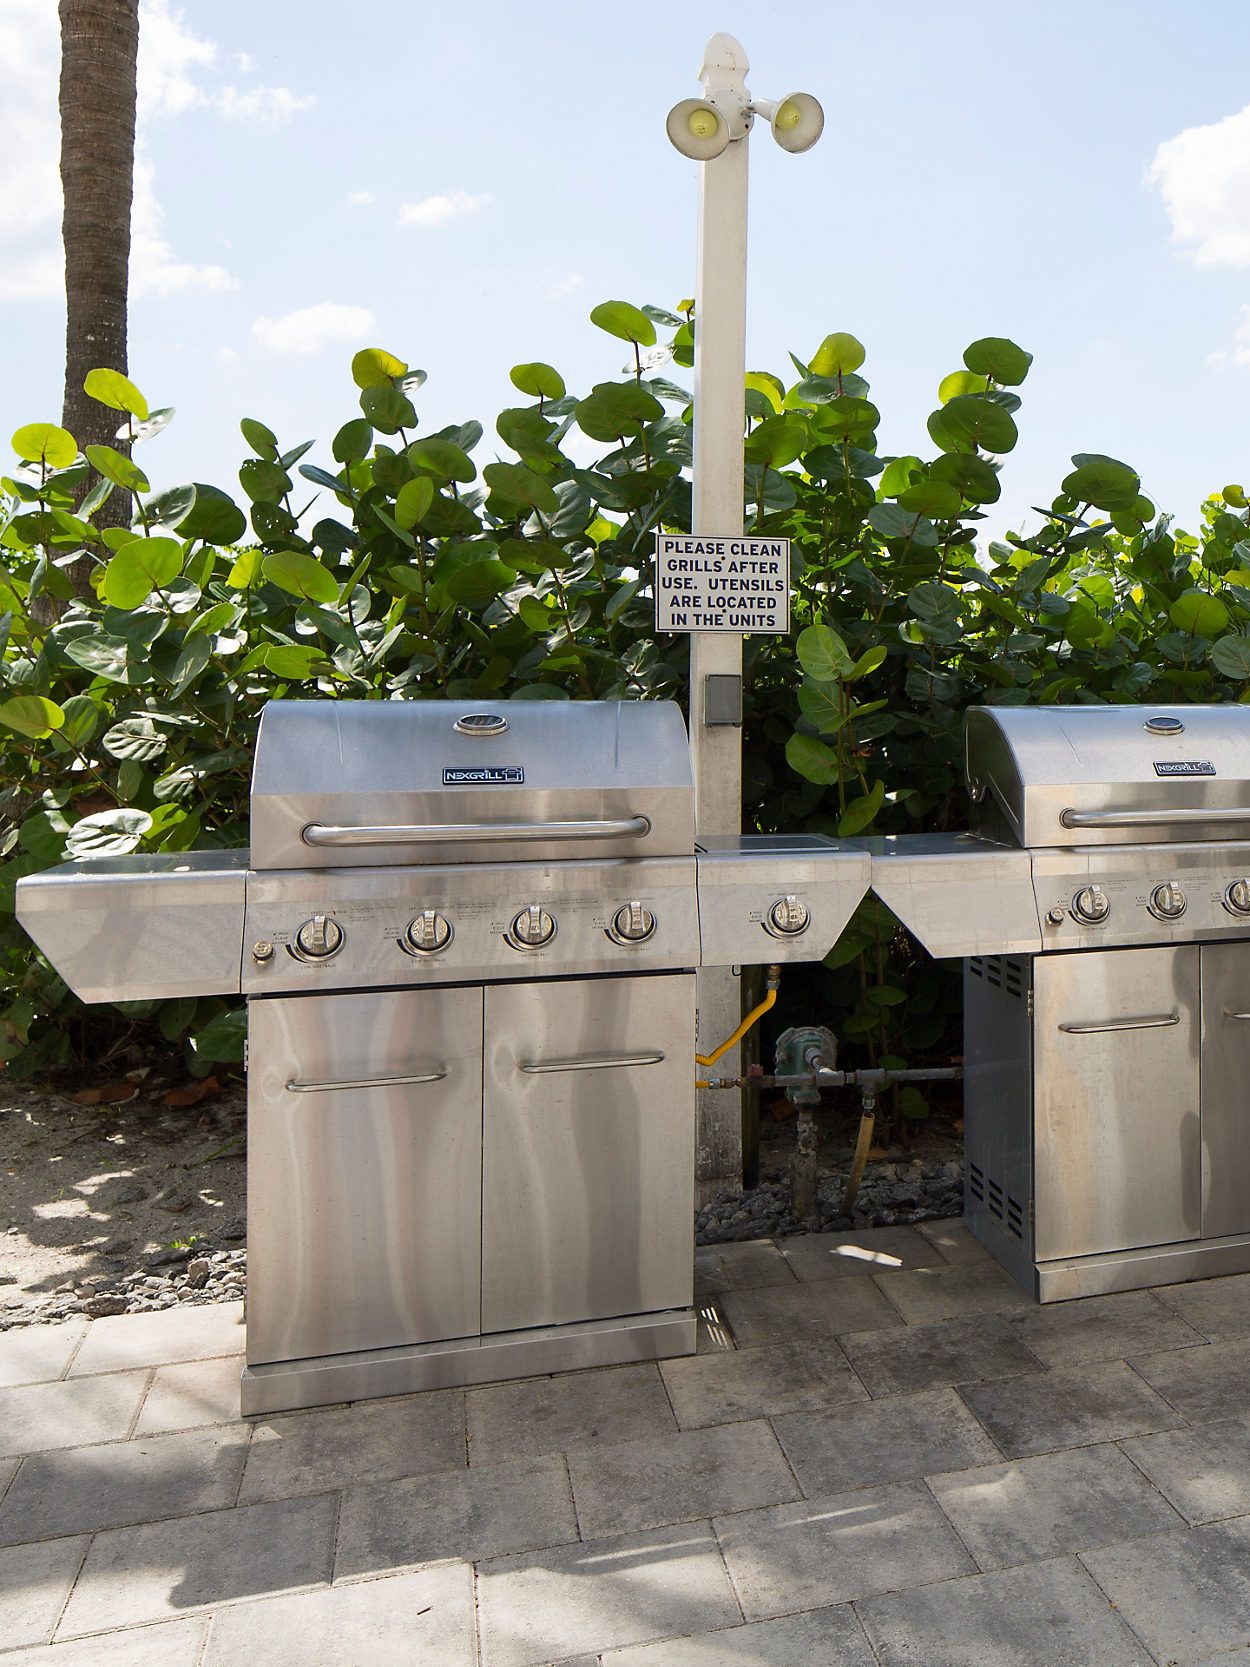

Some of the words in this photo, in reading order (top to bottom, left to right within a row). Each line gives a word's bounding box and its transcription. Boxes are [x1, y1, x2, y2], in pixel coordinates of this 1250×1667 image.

[664, 541, 725, 555] PLEASE
[730, 543, 781, 557] CLEAN
[667, 559, 723, 572] GRILLS
[728, 561, 779, 574] AFTER
[662, 577, 698, 590] USE.
[708, 578, 784, 592] UTENSILS
[669, 595, 701, 608] ARE
[707, 596, 777, 609] LOCATED
[671, 613, 687, 625] IN
[693, 613, 724, 626] THE
[729, 614, 776, 627] UNITS
[446, 769, 503, 780] NEXGRILL
